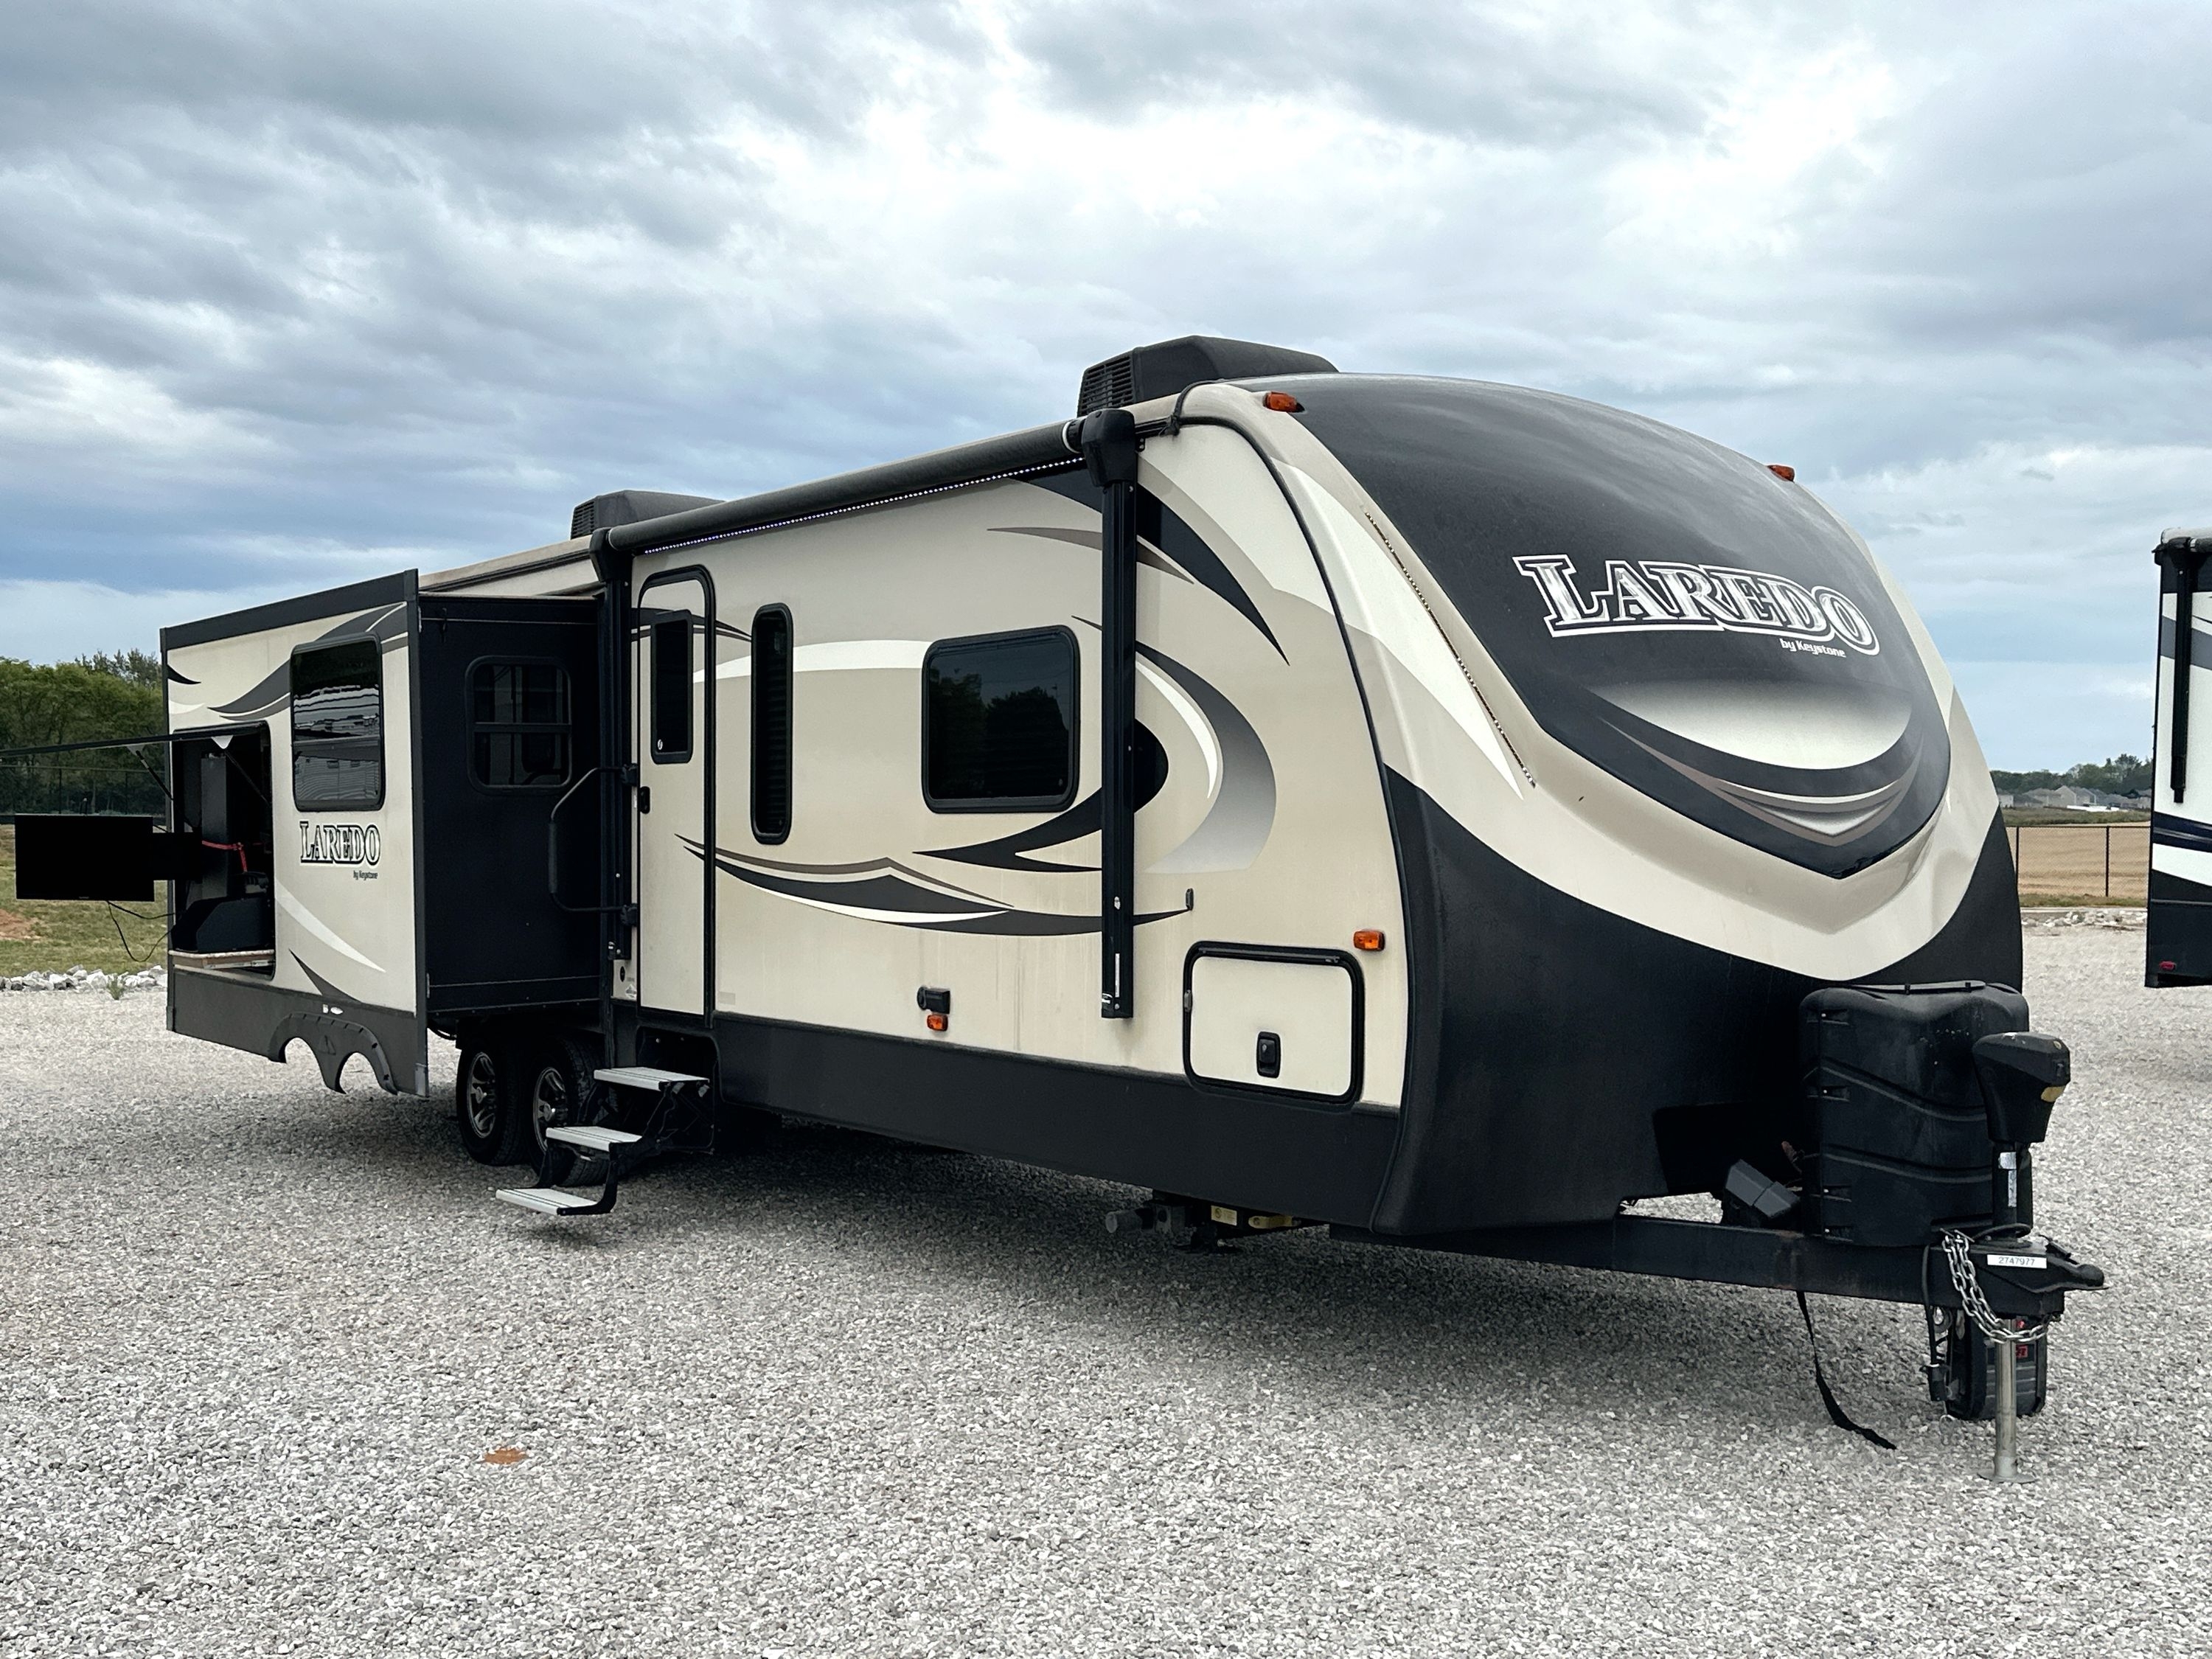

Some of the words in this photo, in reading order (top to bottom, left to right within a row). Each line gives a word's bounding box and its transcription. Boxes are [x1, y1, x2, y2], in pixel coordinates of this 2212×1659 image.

[1512, 554, 1879, 655] LAREDO
[1779, 638, 1797, 652] by
[1795, 640, 1846, 658] Keystone
[299, 821, 381, 866] LAREDO
[1998, 1256, 2035, 1266] 2747977
